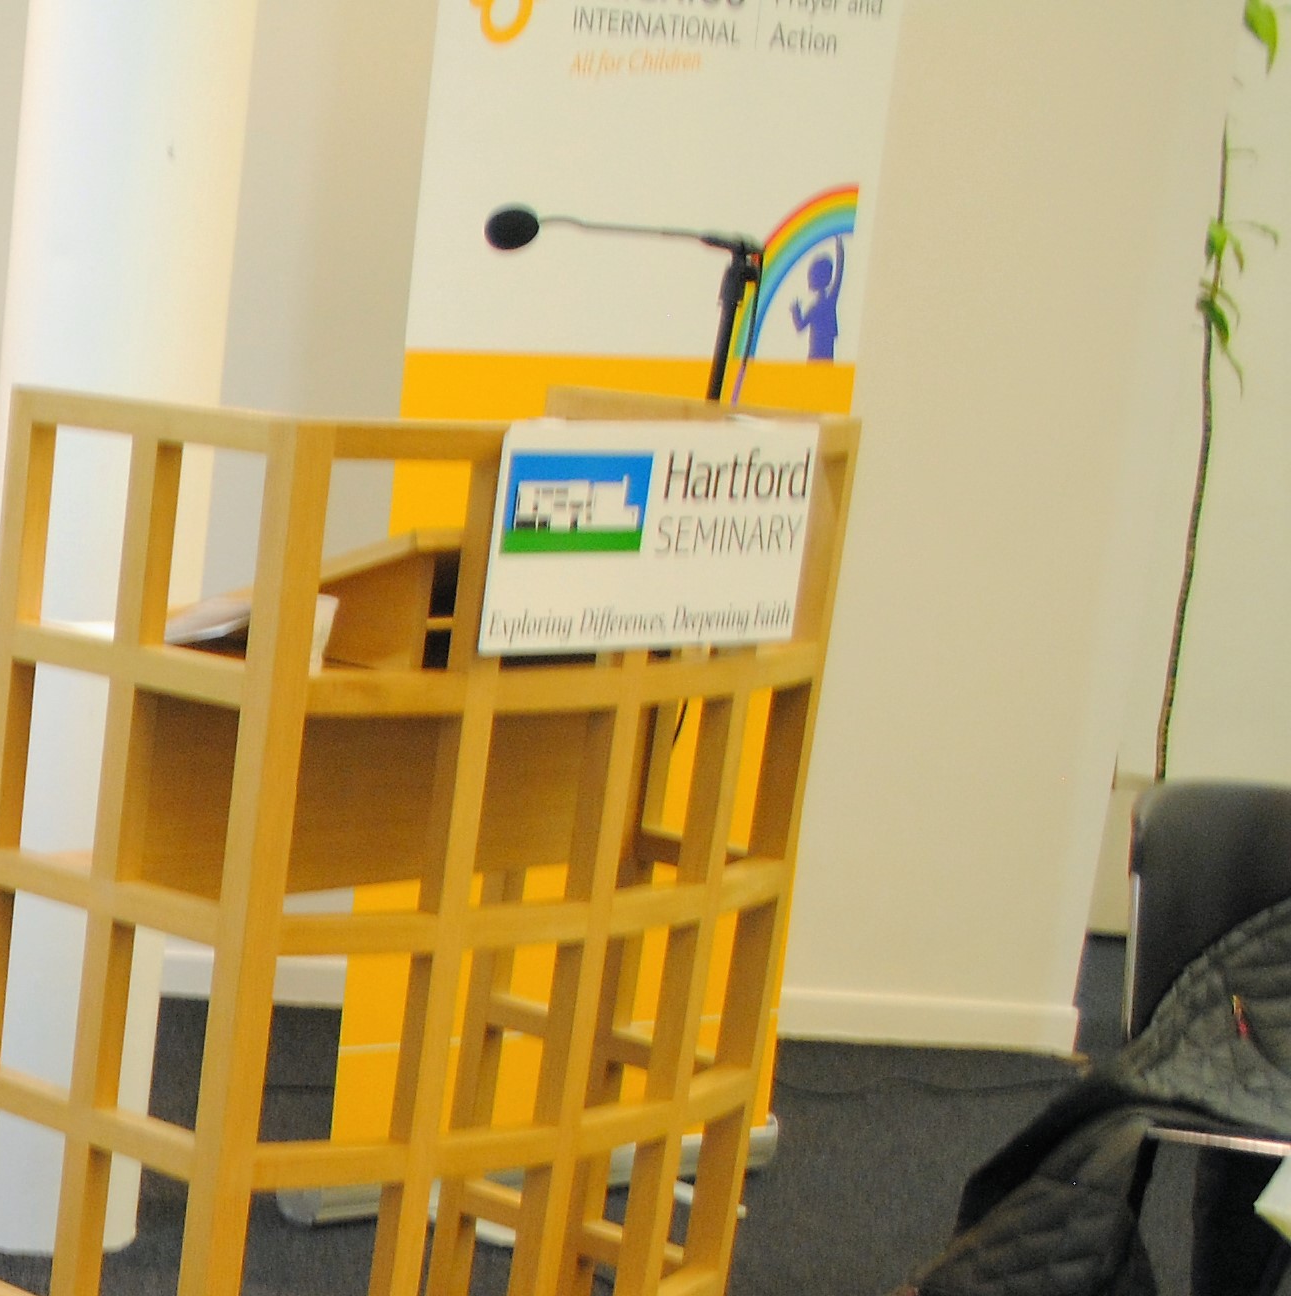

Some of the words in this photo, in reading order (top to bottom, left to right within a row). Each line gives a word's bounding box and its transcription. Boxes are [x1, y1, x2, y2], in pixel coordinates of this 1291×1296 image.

[572, 6, 740, 45] INTERNATIONAL
[769, 22, 837, 54] Action
[571, 51, 593, 75] All
[598, 50, 620, 79] for
[628, 48, 702, 74] Children
[663, 448, 812, 500] Hartford
[656, 514, 803, 552] SEMINARY
[489, 609, 572, 643] Exploring
[673, 603, 750, 637] Deepening
[754, 600, 790, 628] Faith
